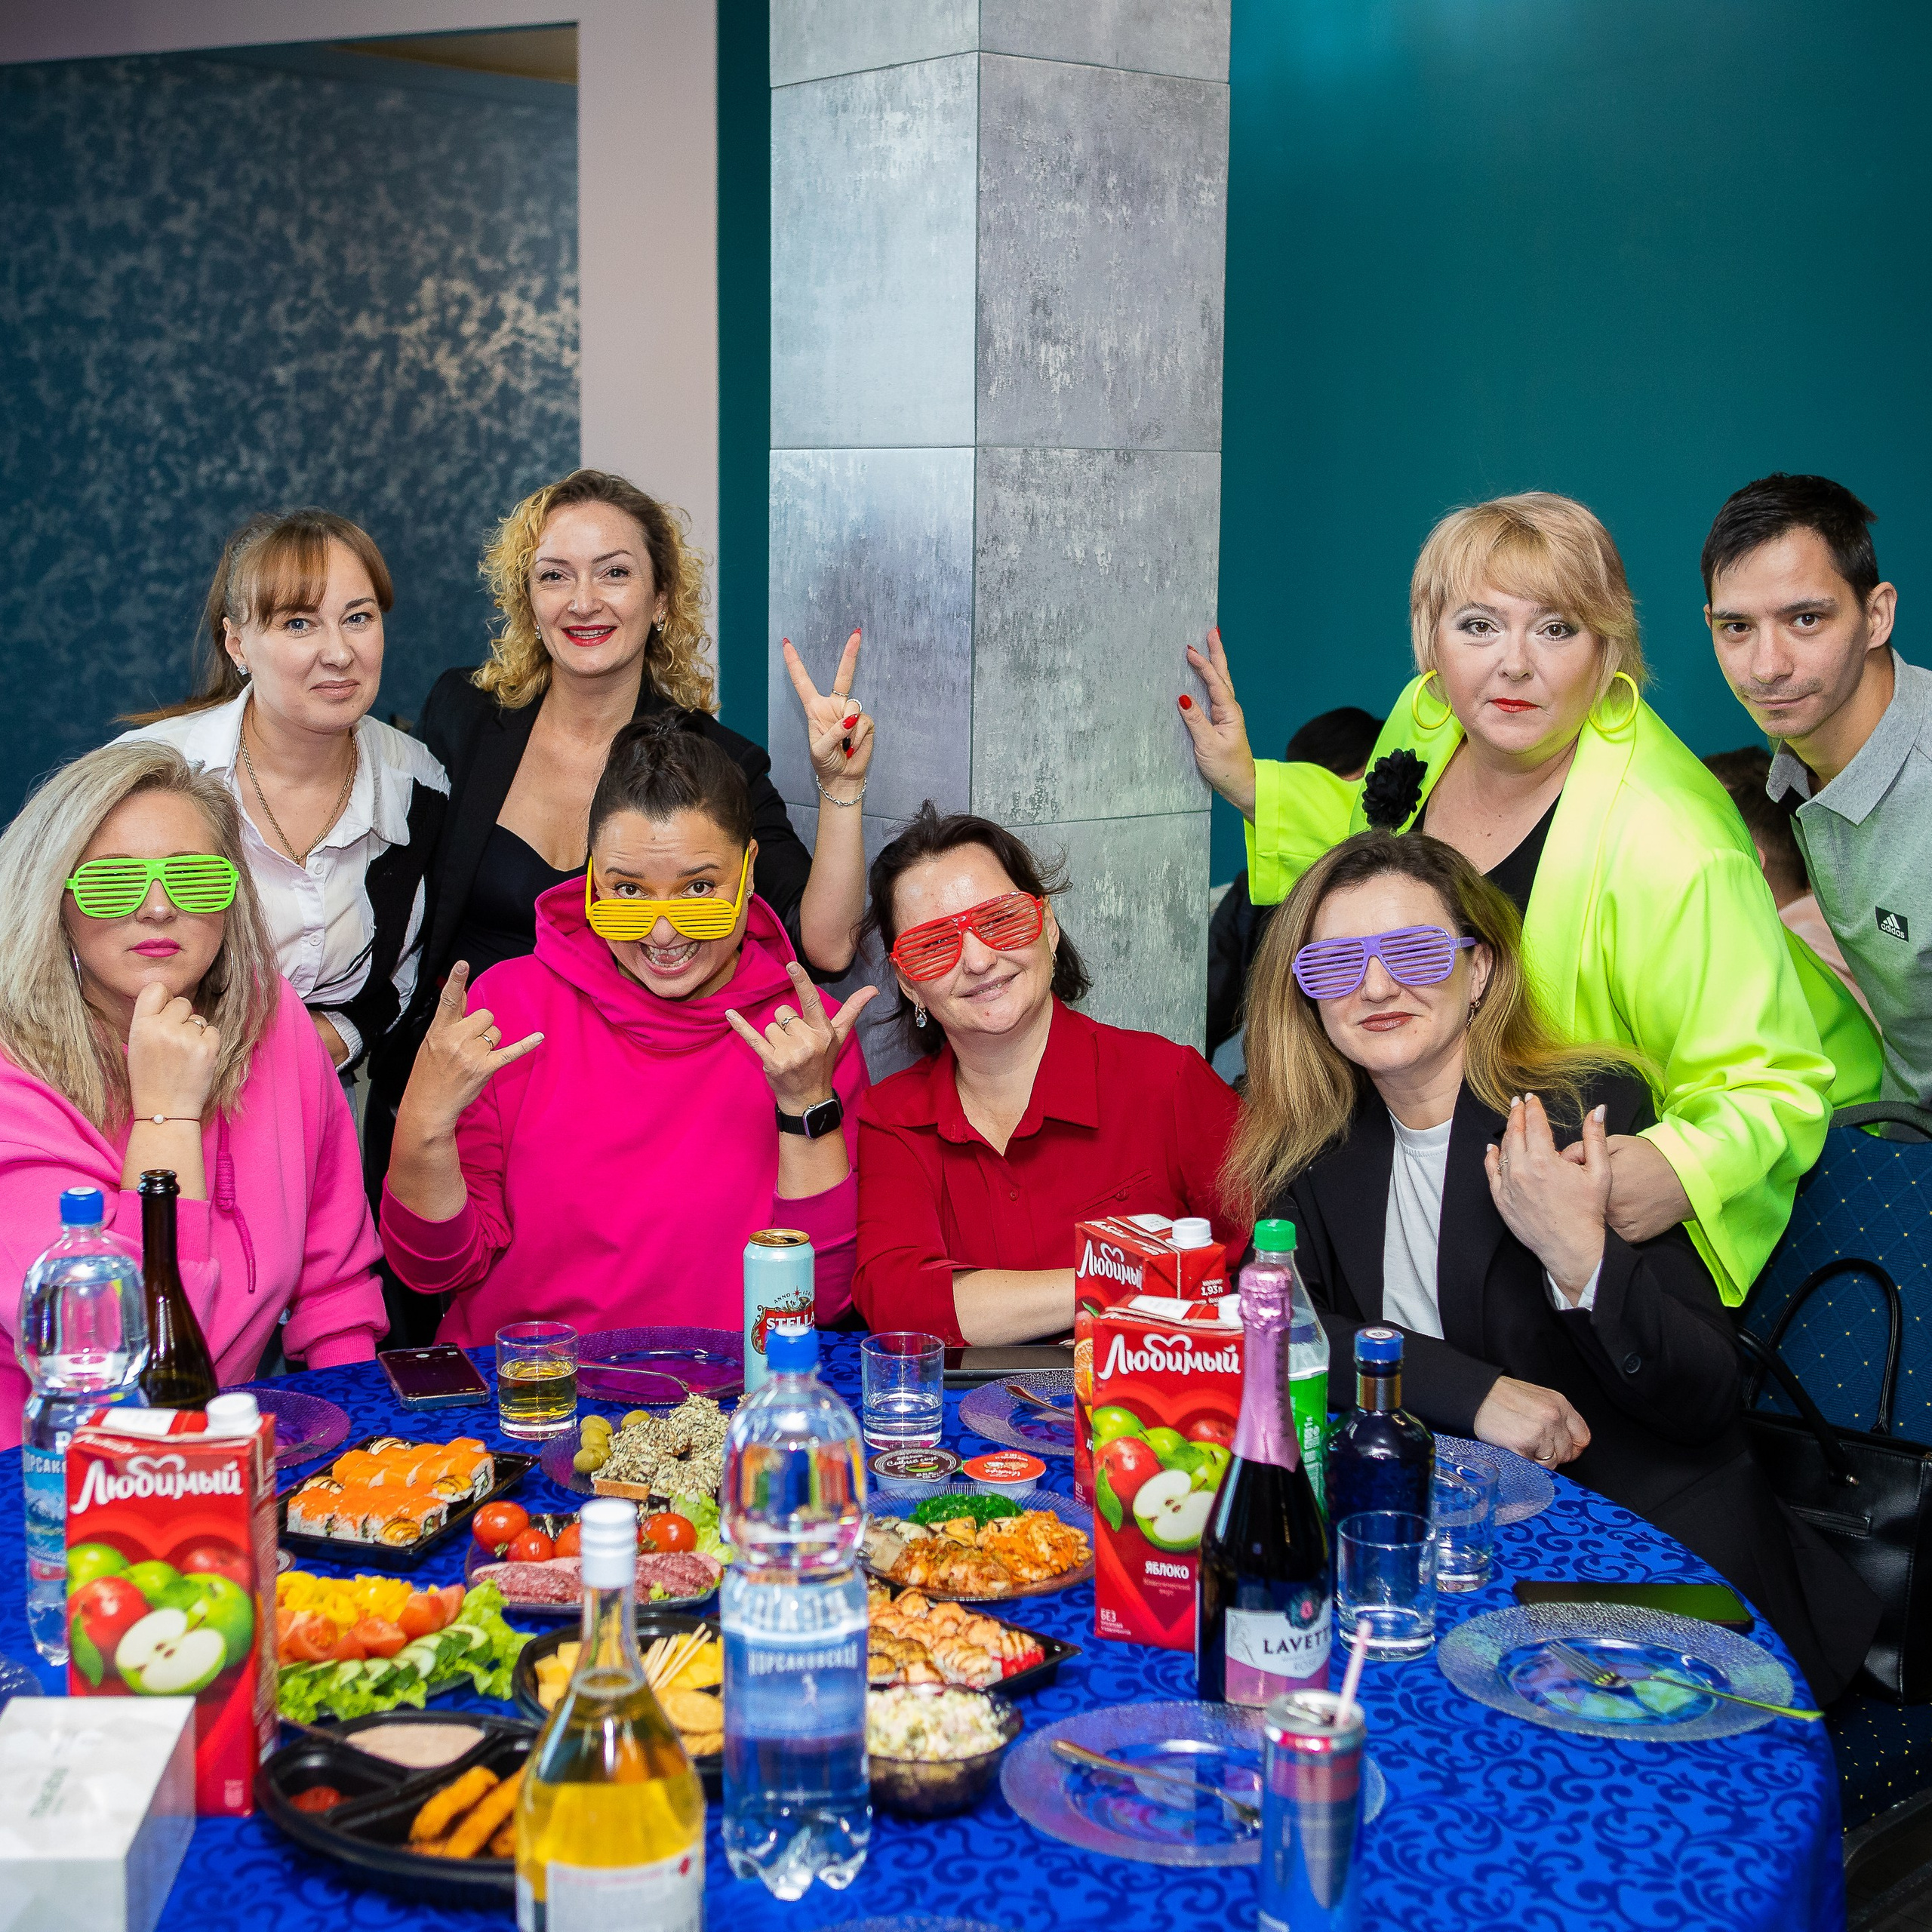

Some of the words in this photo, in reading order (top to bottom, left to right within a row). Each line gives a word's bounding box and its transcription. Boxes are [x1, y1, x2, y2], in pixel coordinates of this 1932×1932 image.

[1881, 922, 1905, 939] adidas
[1077, 1239, 1143, 1291] Любимый
[774, 1293, 791, 1304] ANNO
[1097, 1333, 1241, 1380] Любимый
[69, 1454, 244, 1515] Любимый
[1144, 1560, 1190, 1580] ЯБЛОКО
[1100, 1607, 1117, 1623] БЕЗ
